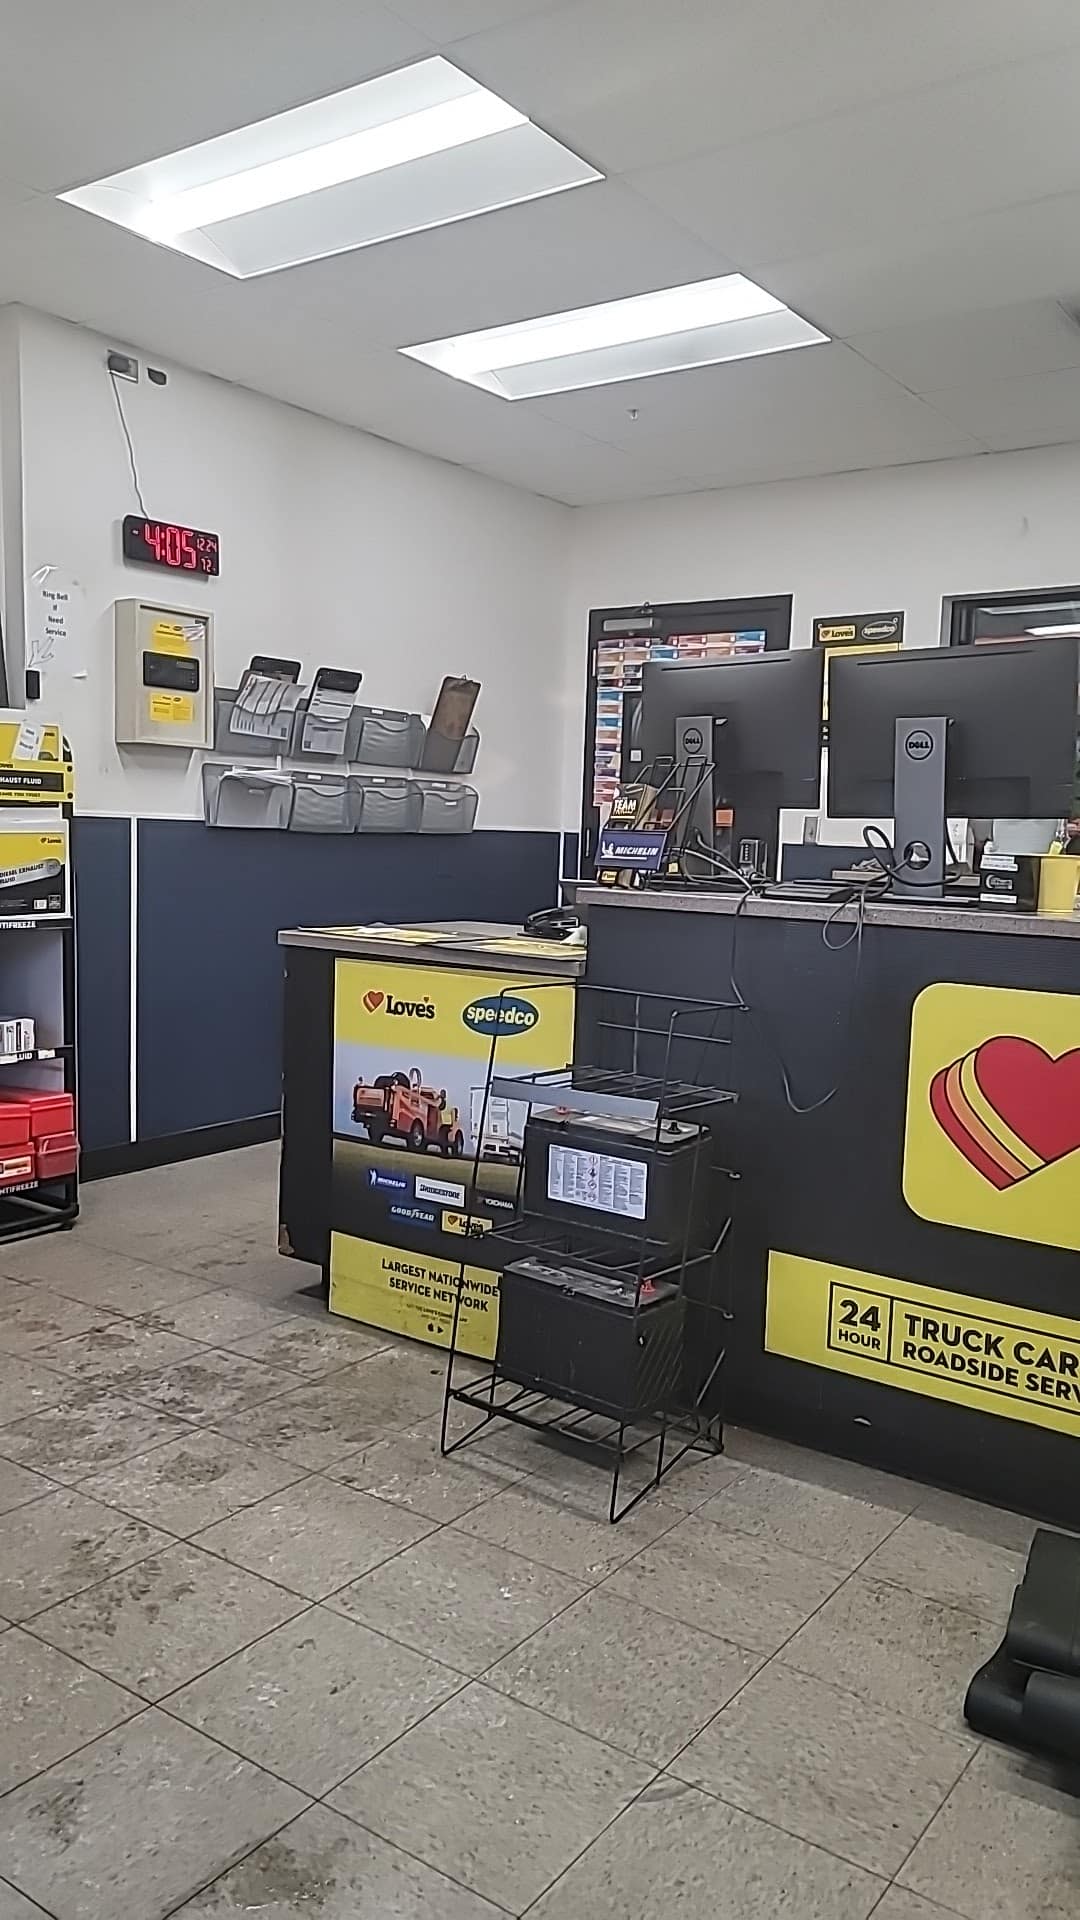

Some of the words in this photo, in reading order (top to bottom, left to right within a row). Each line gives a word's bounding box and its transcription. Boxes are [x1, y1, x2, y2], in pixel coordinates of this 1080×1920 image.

[144, 523, 197, 569] 4:05
[42, 590, 56, 601] Ring
[56, 592, 69, 601] Bell
[48, 615, 64, 625] Need
[45, 626, 67, 637] Service
[908, 740, 930, 749] DELL
[23, 777, 42, 785] FLUID
[613, 799, 637, 812] TEAM
[614, 846, 659, 856] MICHELIN
[386, 994, 436, 1020] Love's
[466, 1005, 535, 1026] speedco
[377, 1177, 407, 1189] MICHELIN
[419, 1183, 461, 1200] BRIDGESTONE
[391, 1206, 435, 1222] GOODYEAR
[381, 1257, 427, 1279] LARGEST
[428, 1270, 499, 1297] NATIONWIDE
[389, 1276, 432, 1298] SERVICE
[433, 1288, 489, 1313] NETWORK
[838, 1299, 882, 1332] 24
[838, 1328, 882, 1351] HOUR
[903, 1313, 1006, 1360] TRUCK
[1012, 1341, 1080, 1379] CAR
[902, 1341, 1020, 1388] ROADSIDE
